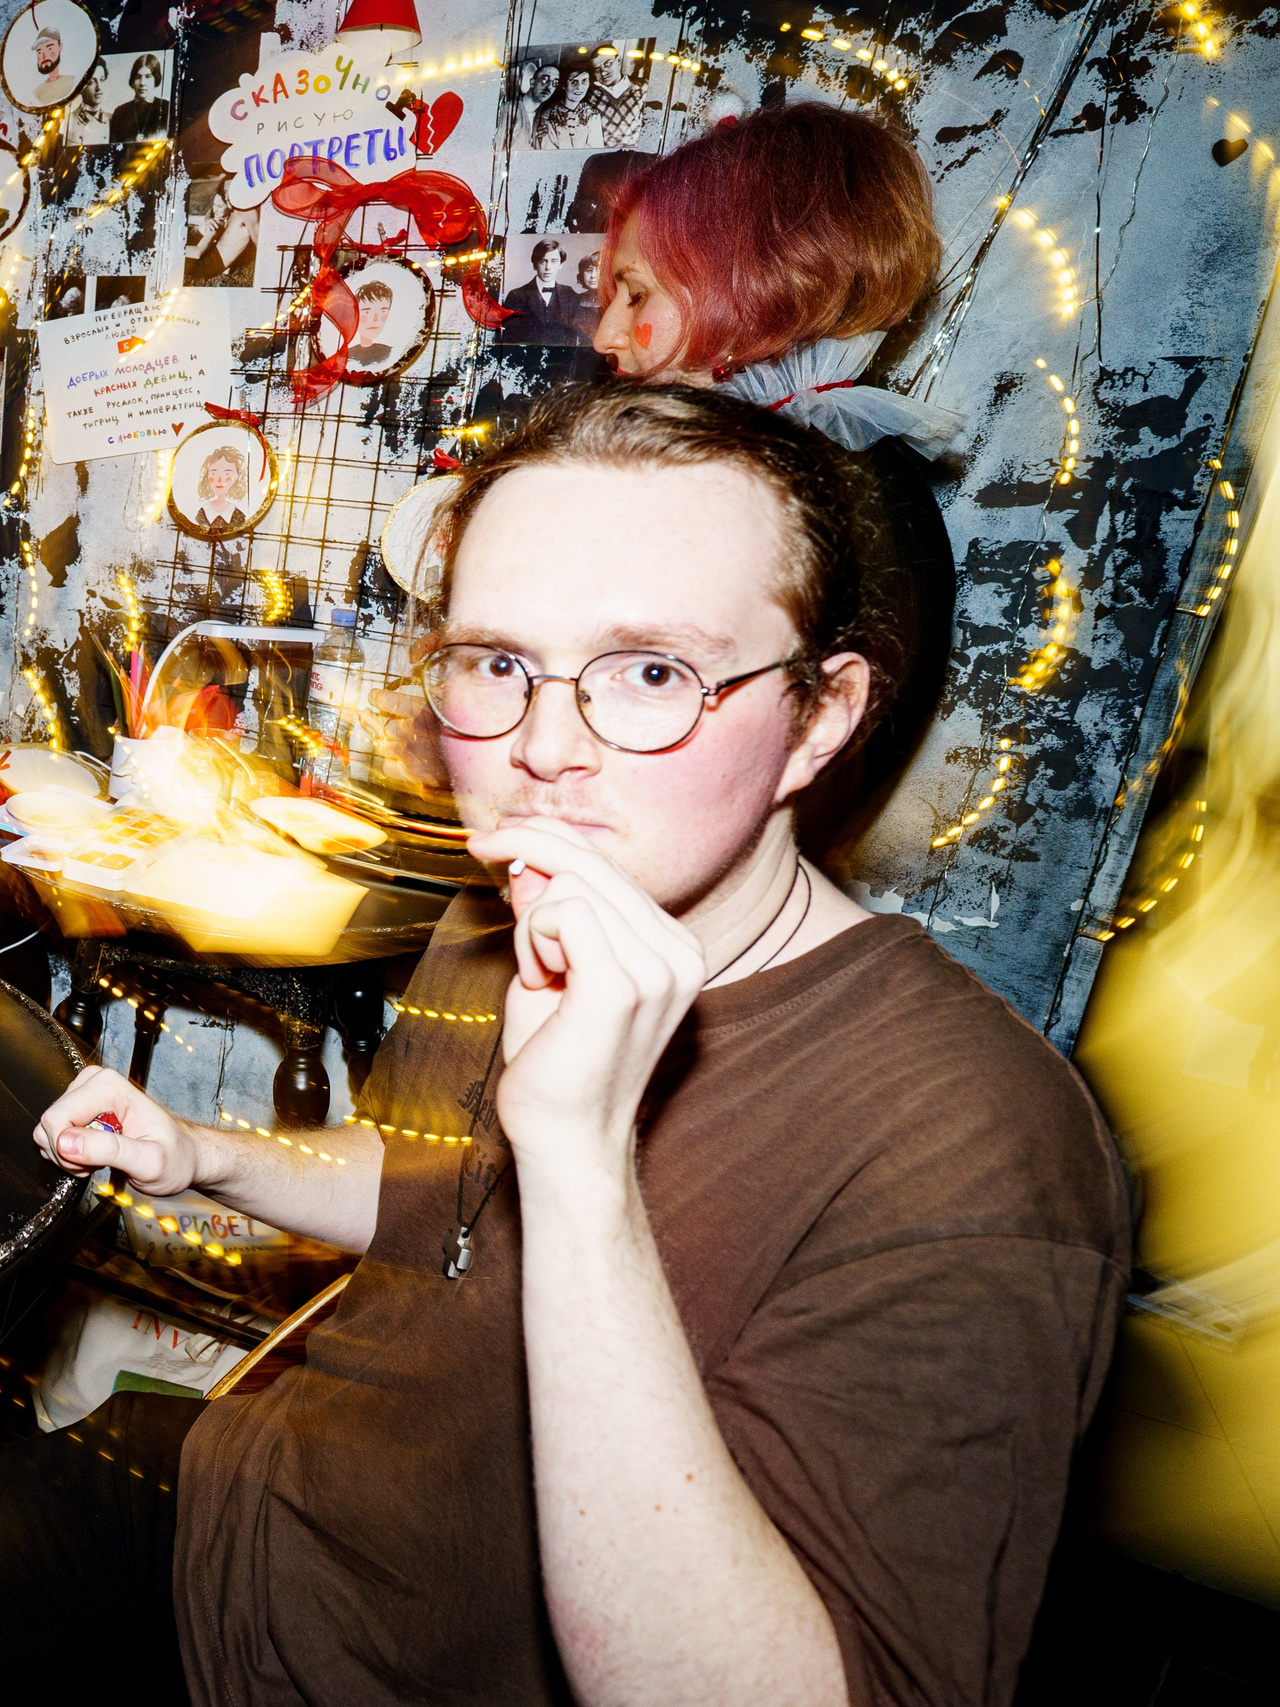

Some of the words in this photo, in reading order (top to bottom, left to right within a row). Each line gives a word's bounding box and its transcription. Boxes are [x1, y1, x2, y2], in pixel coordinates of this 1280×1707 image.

[256, 109, 354, 135] РИСУЮ
[243, 126, 407, 188] ПОРТРЕТЫ
[64, 326, 109, 344] ВЗРОСЛЫХ
[104, 325, 137, 340] ЛЮДЕЙ
[66, 369, 109, 390] ДОБРЫХ
[114, 354, 179, 375] МОЛОДЦЕВ
[94, 380, 138, 398] КРАСНЫХ
[143, 370, 193, 389] ДЕВИЦ,
[66, 406, 94, 419] ТАКЖЕ
[106, 396, 149, 409] РУСАЛОК,
[82, 414, 120, 430] ТИГРИЦ
[157, 1214, 256, 1239] ПРИВЕТ
